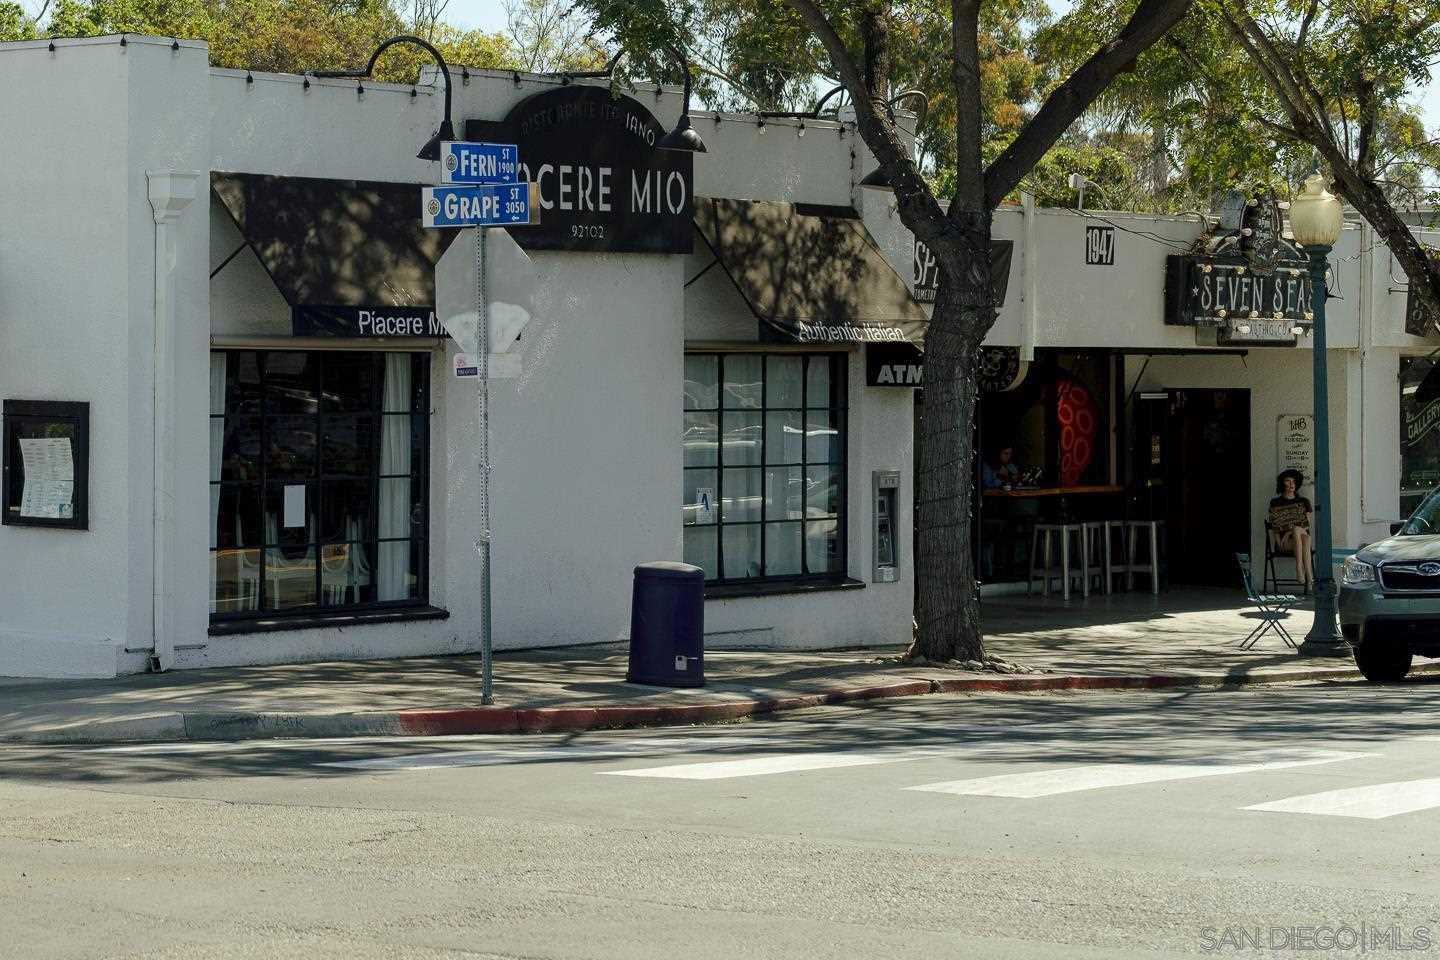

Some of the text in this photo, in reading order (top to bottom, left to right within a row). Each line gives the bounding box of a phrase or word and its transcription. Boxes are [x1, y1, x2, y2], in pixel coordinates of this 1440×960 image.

[460, 148, 511, 177] FERN ST
[498, 161, 515, 174] 1900
[444, 188, 520, 220] GRAPE ST
[630, 169, 686, 215] MIO
[505, 201, 525, 214] 3050
[571, 224, 604, 239] 92102
[1087, 229, 1115, 263] 1947
[1201, 275, 1264, 312] SEVEN
[358, 310, 423, 335] Piacere
[799, 320, 862, 341] Authentic
[876, 364, 924, 384] ATM
